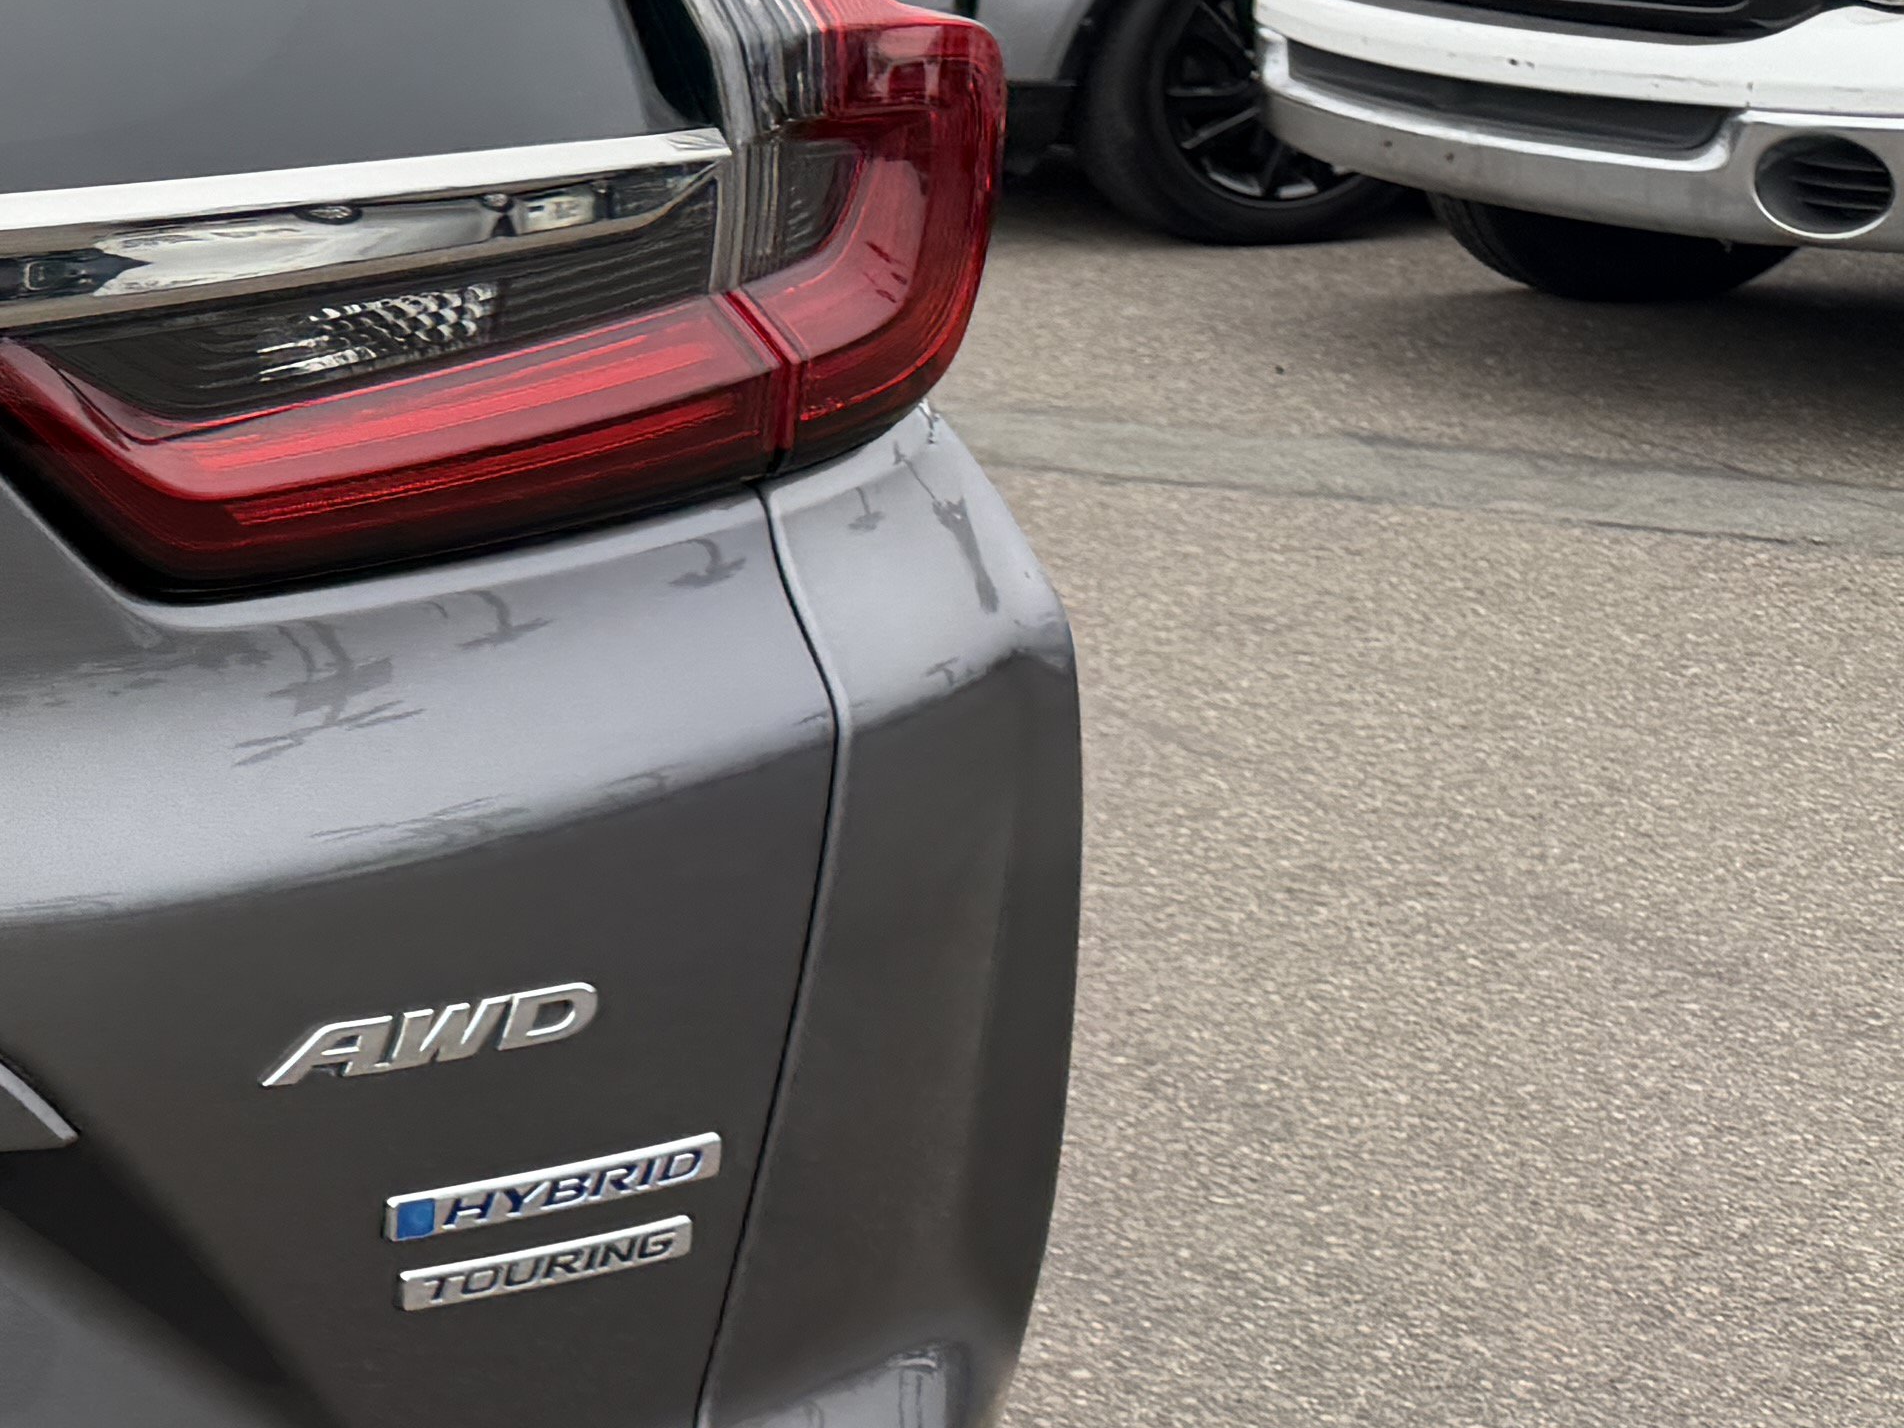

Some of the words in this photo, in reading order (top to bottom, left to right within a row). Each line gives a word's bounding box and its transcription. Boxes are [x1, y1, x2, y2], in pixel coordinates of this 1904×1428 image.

[259, 981, 598, 1087] AWD
[442, 1148, 704, 1230] HYBRID
[422, 1228, 678, 1303] TOURING
